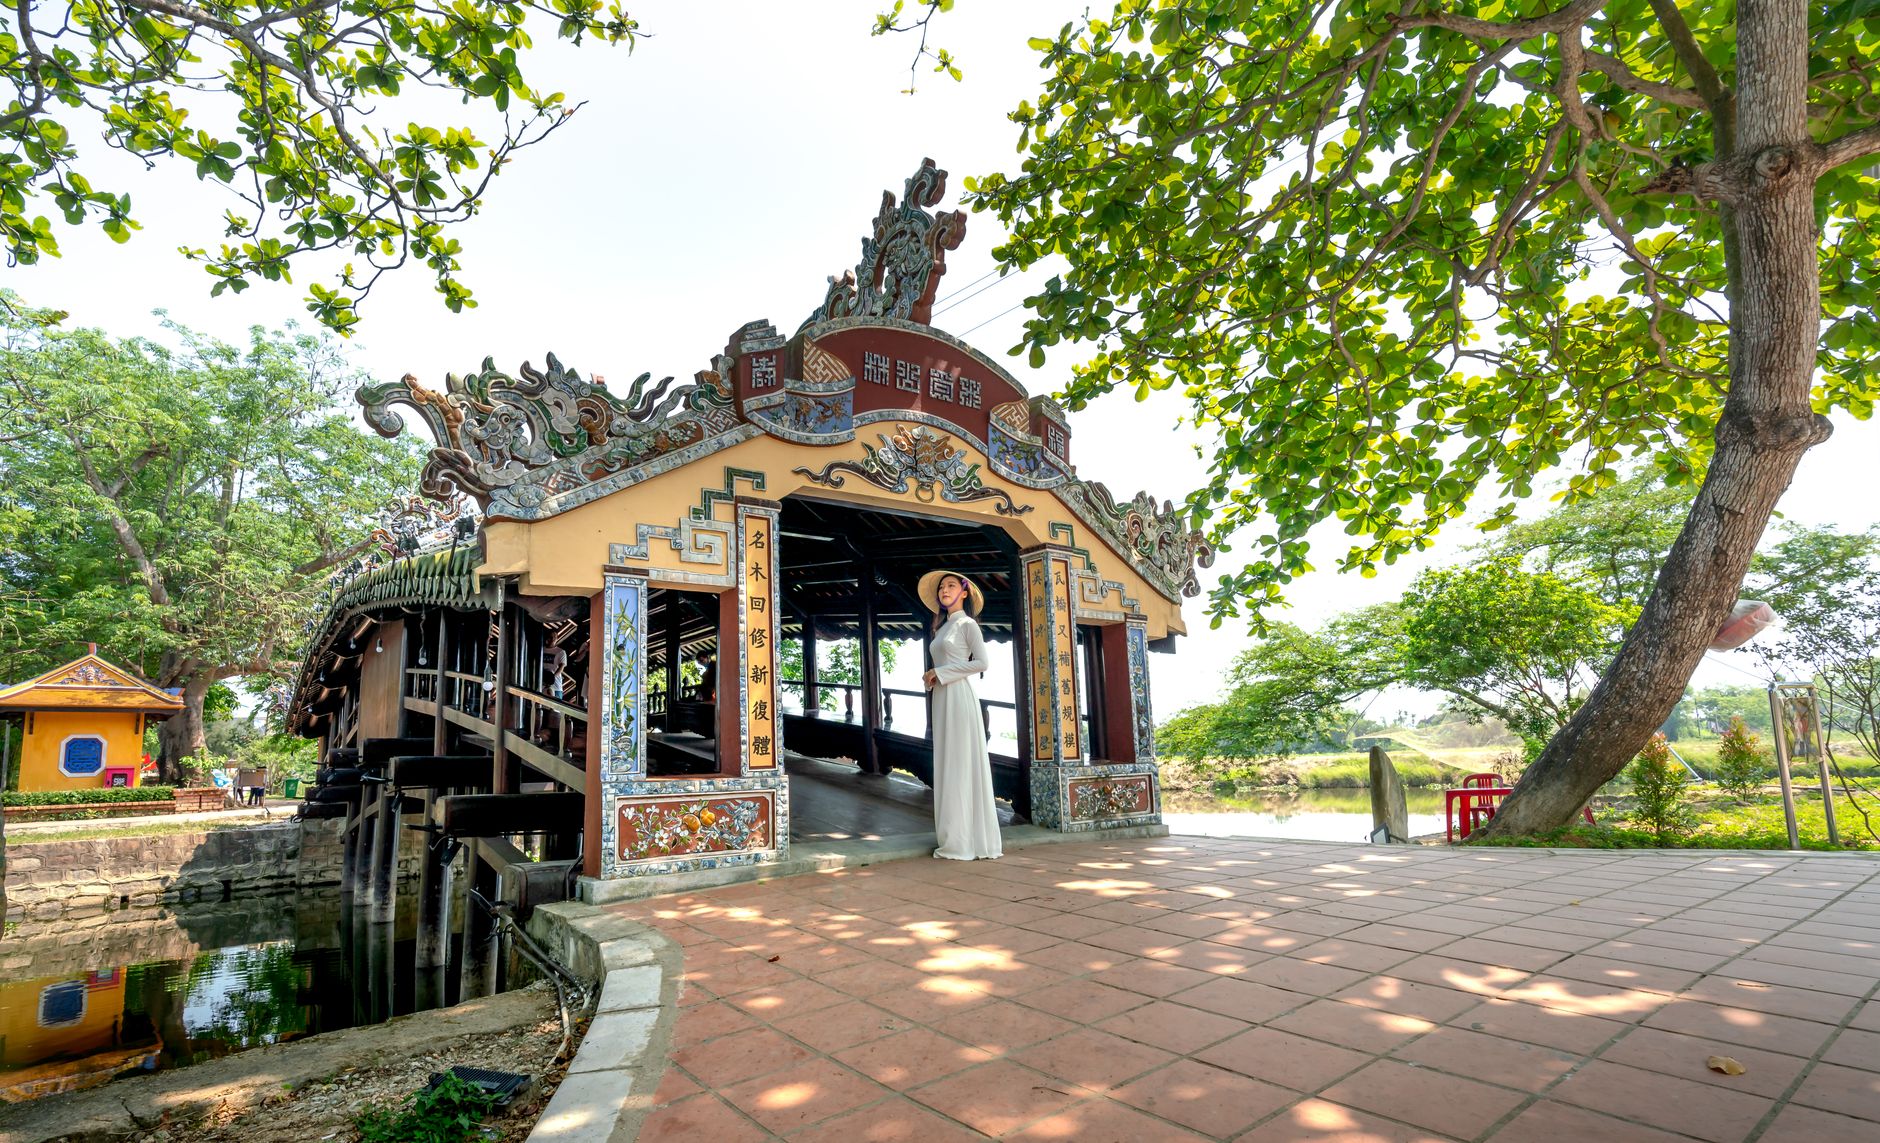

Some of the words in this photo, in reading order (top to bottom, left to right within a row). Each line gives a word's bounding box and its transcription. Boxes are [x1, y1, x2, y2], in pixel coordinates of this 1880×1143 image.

[748, 529, 771, 757] 名木回修新復體
[1053, 570, 1076, 750] 瓦橋又補舊規模
